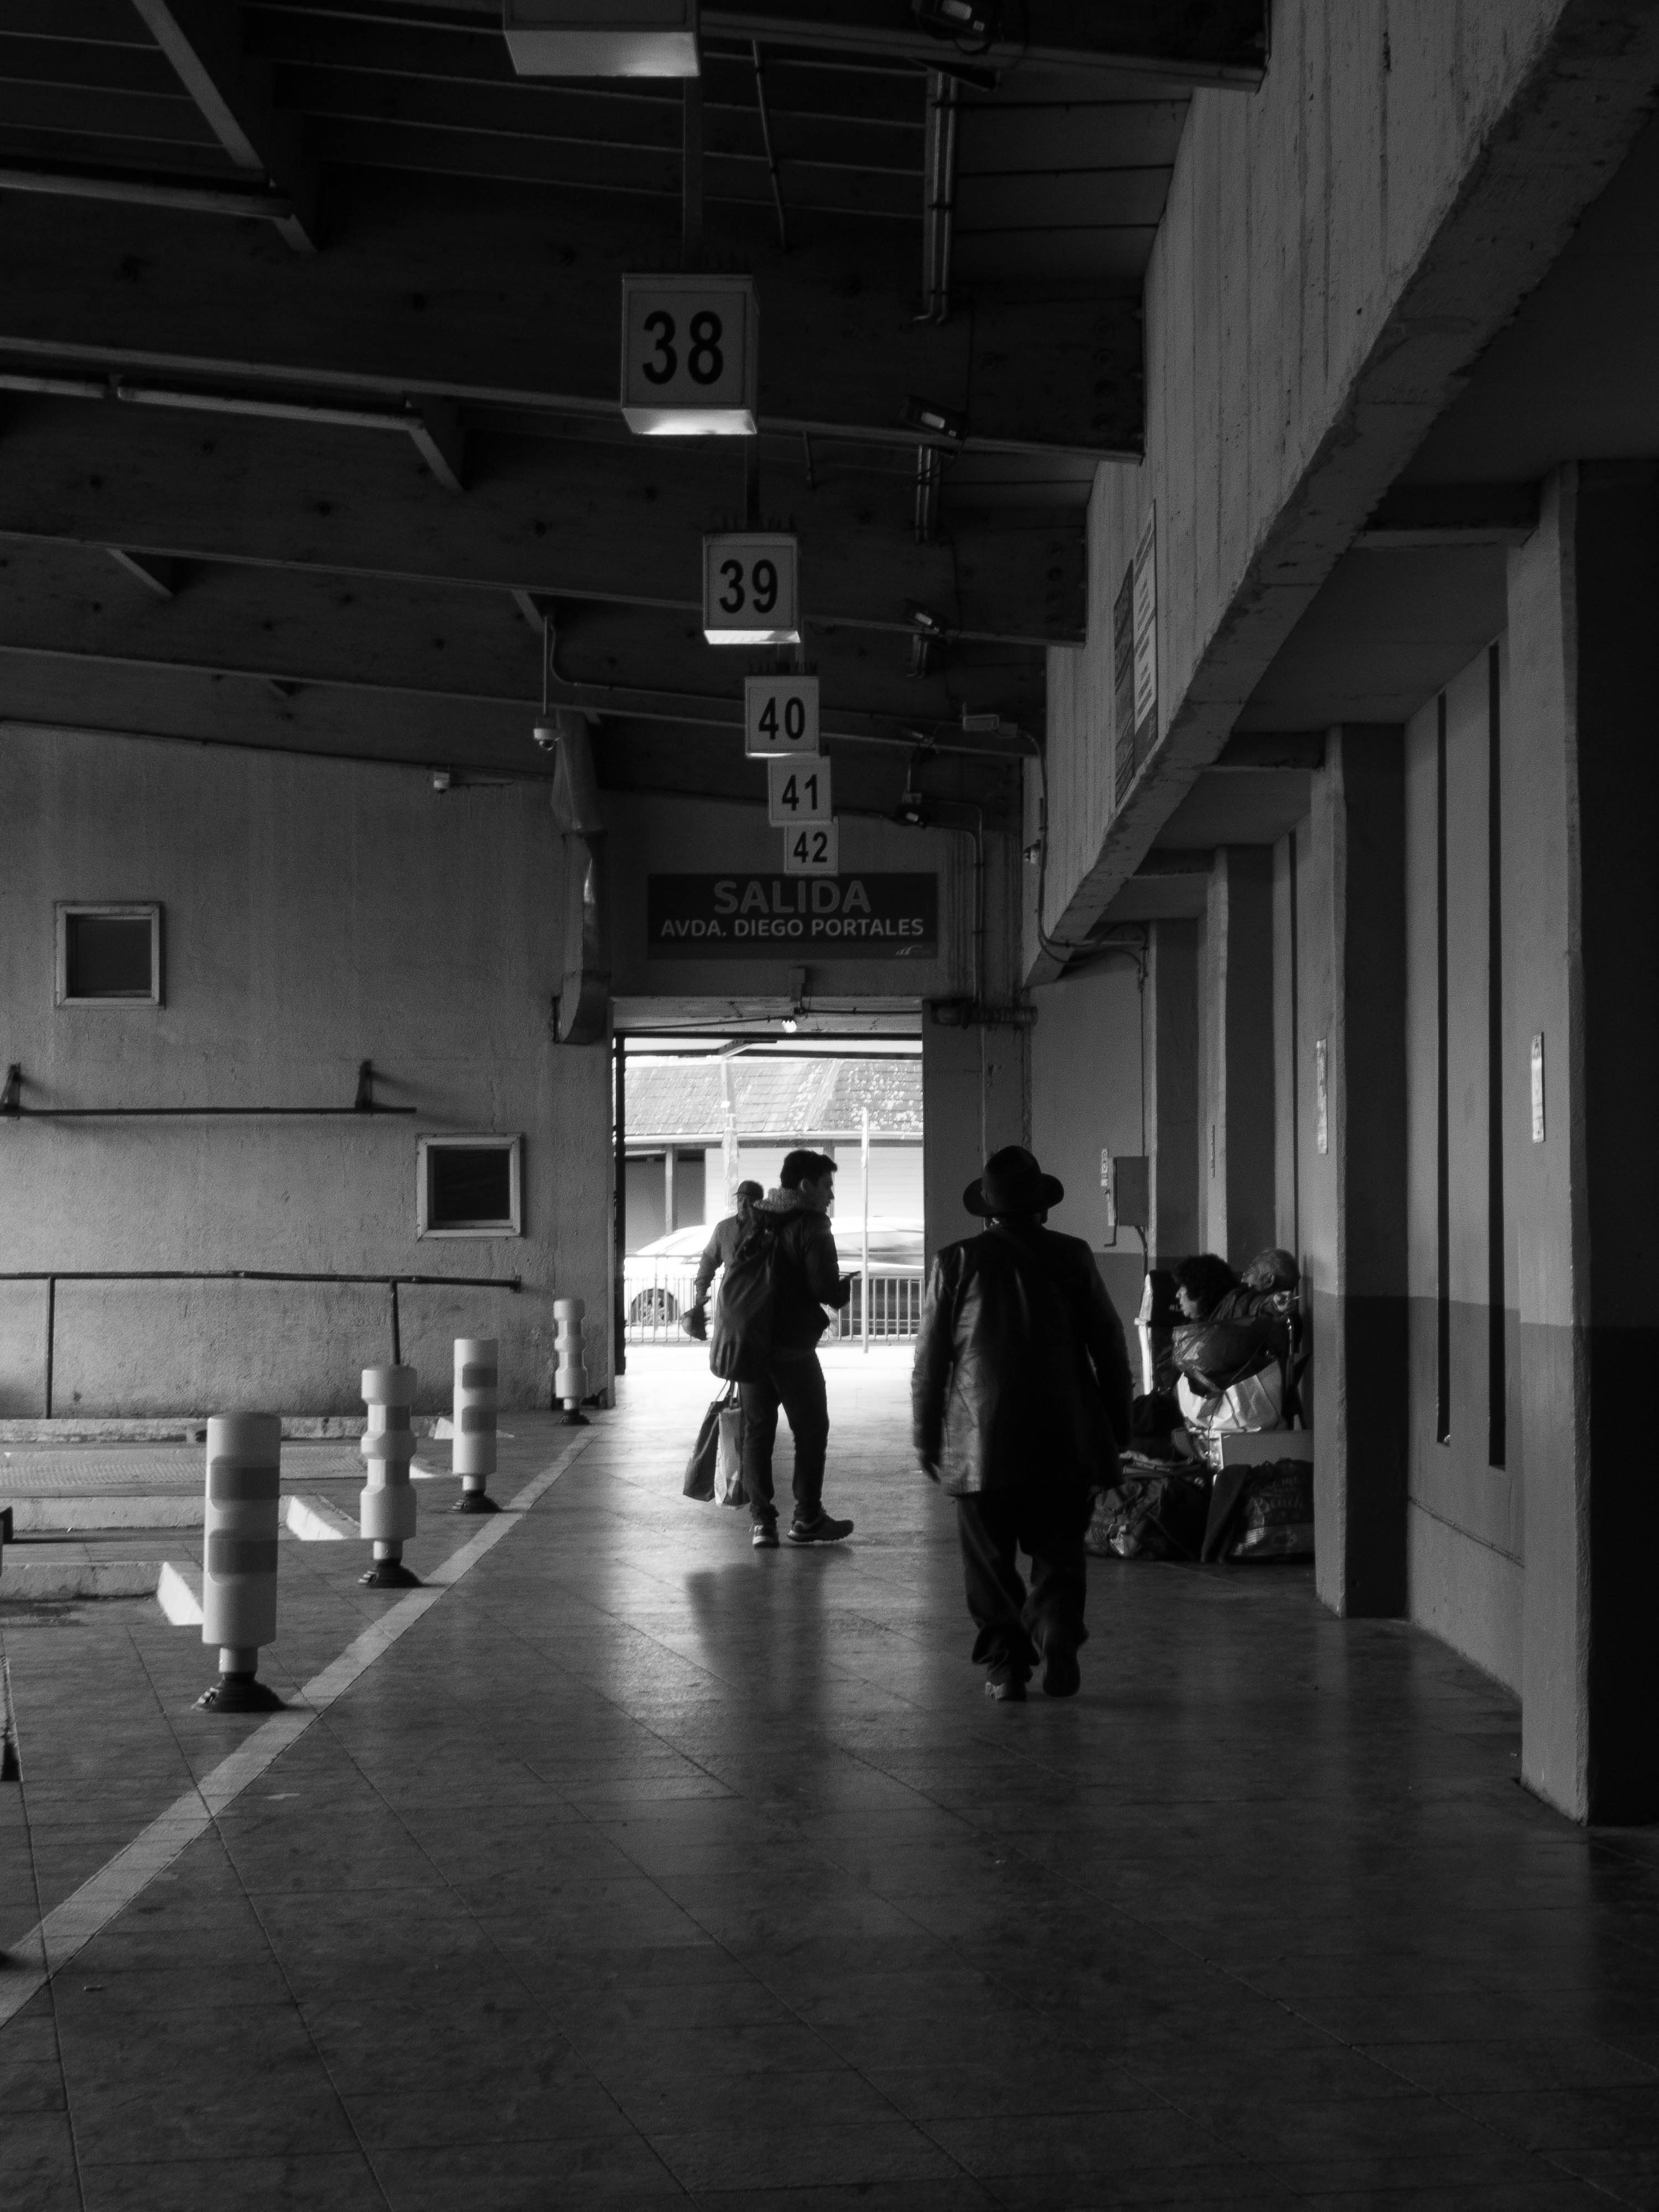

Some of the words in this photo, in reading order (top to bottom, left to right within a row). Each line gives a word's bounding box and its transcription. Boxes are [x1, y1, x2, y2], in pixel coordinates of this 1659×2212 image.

[642, 310, 724, 385] 38
[719, 558, 779, 614] 39
[758, 697, 806, 740] 40
[781, 774, 818, 811] 41
[793, 831, 828, 863] 42
[713, 879, 872, 914] SALIDA
[660, 919, 727, 937] AVDA.
[734, 919, 803, 936] DIEGO
[811, 918, 924, 936] PORTALES
